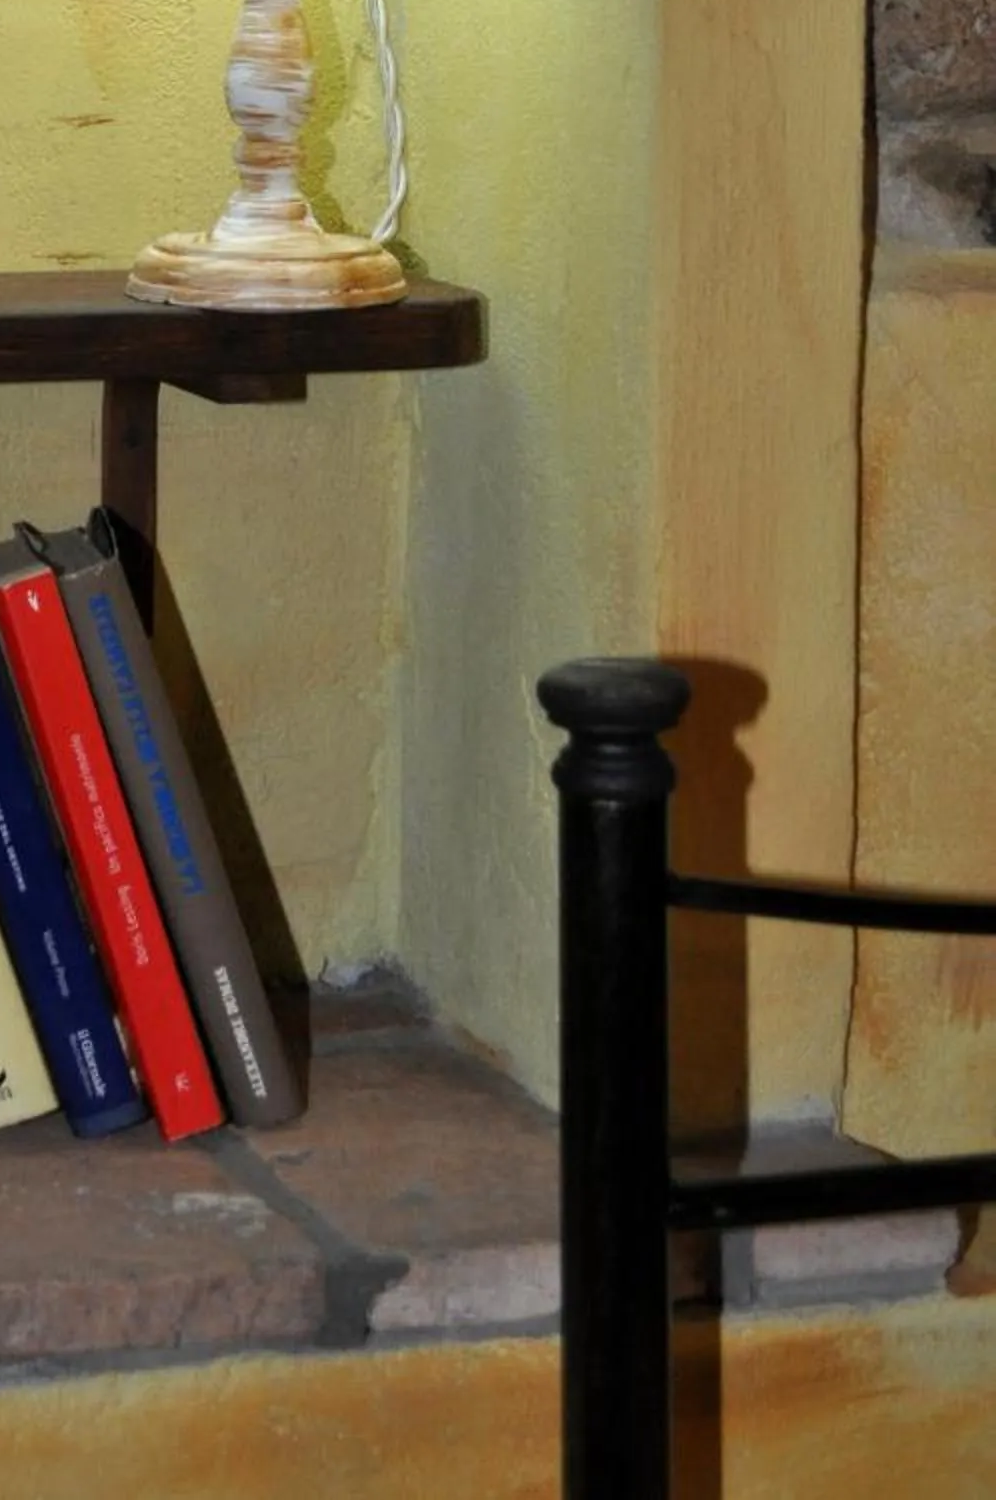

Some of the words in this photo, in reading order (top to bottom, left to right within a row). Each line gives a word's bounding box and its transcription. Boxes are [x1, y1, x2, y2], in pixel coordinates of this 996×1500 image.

[114, 884, 141, 930] Lessing
[214, 965, 237, 1014] DUMAS
[80, 1038, 108, 1097] Giornale
[233, 1018, 265, 1098] ALEXANDRE
